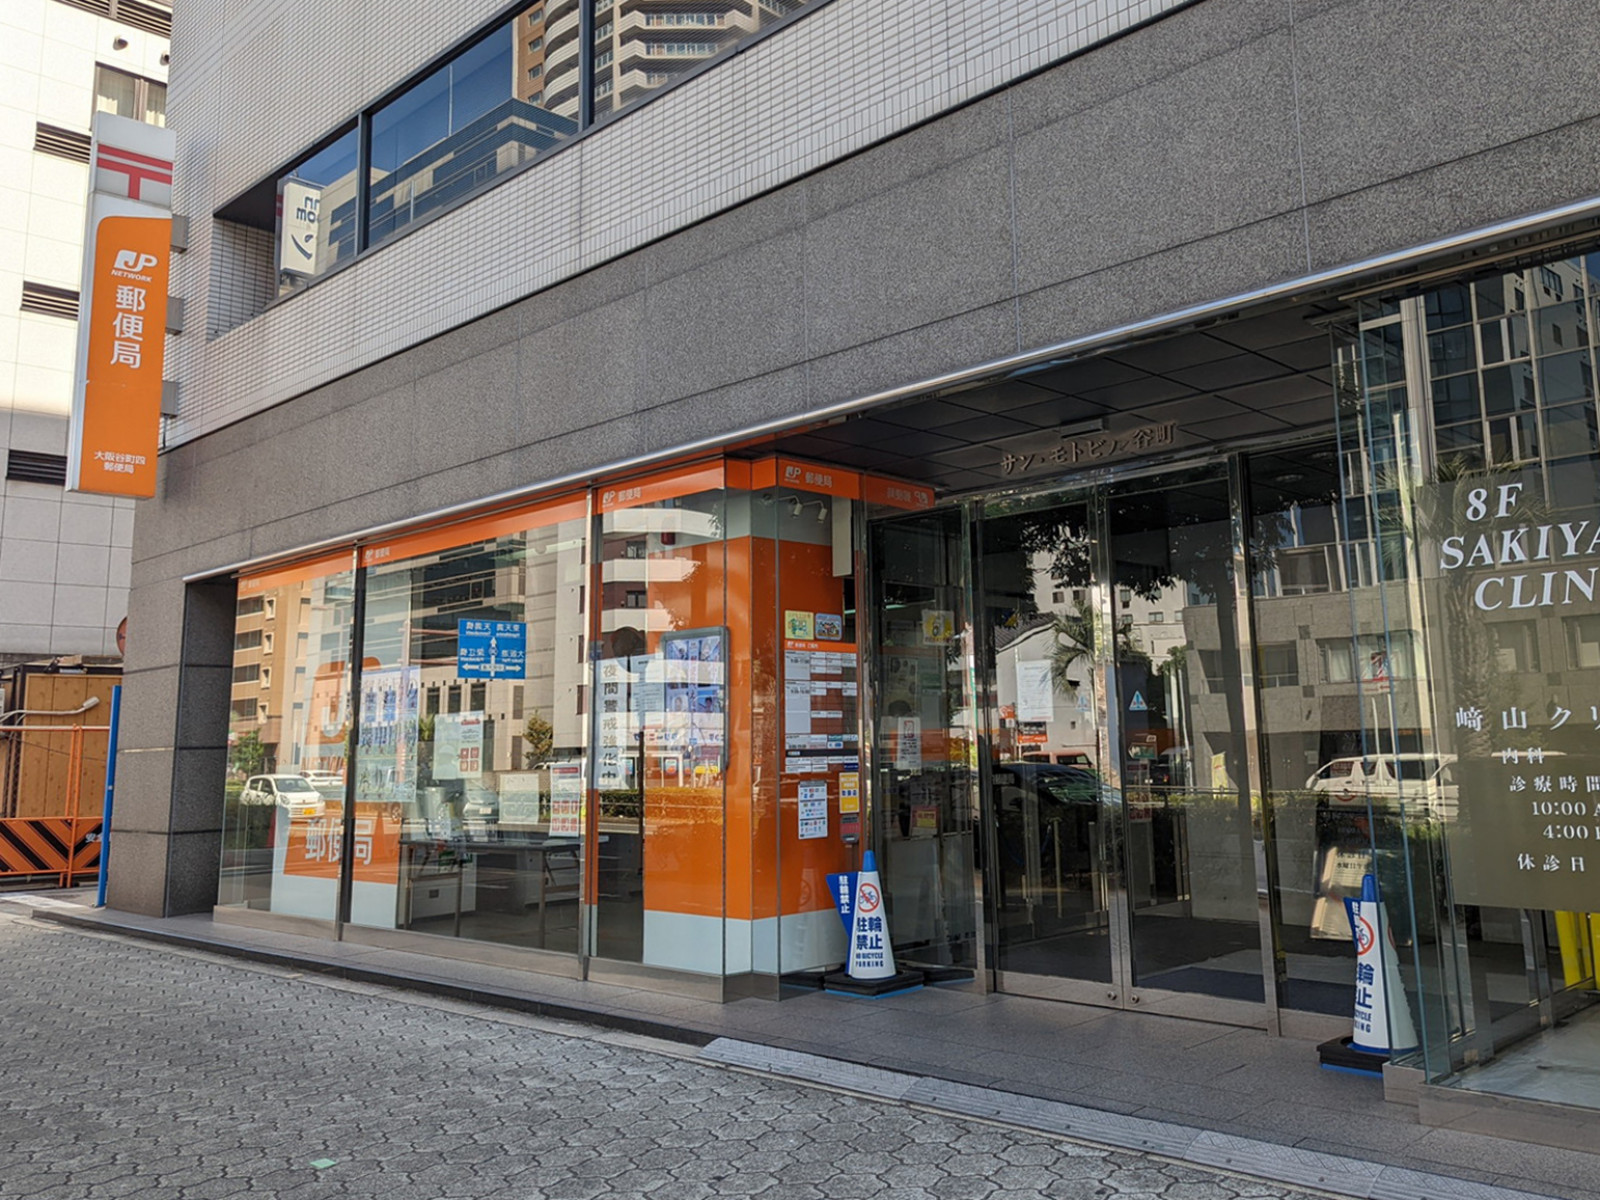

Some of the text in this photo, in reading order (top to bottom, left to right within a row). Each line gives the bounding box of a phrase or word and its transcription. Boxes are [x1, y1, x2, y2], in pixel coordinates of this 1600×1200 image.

[111, 269, 152, 283] NETWORK
[110, 284, 146, 369] 郵便局
[94, 450, 146, 465] 大阪谷町四
[103, 461, 135, 475] 郵便局
[1466, 482, 1523, 521] 8F
[1501, 747, 1545, 765] 内科
[1509, 775, 1600, 793] 診療時間
[1532, 801, 1587, 816] 10:00
[1543, 824, 1589, 840] 4:00
[1517, 853, 1585, 873] 休診日
[838, 875, 851, 914] 駐輪禁止
[856, 916, 882, 933] 駐輪
[856, 934, 884, 950] 禁止
[855, 960, 884, 968] PARKING
